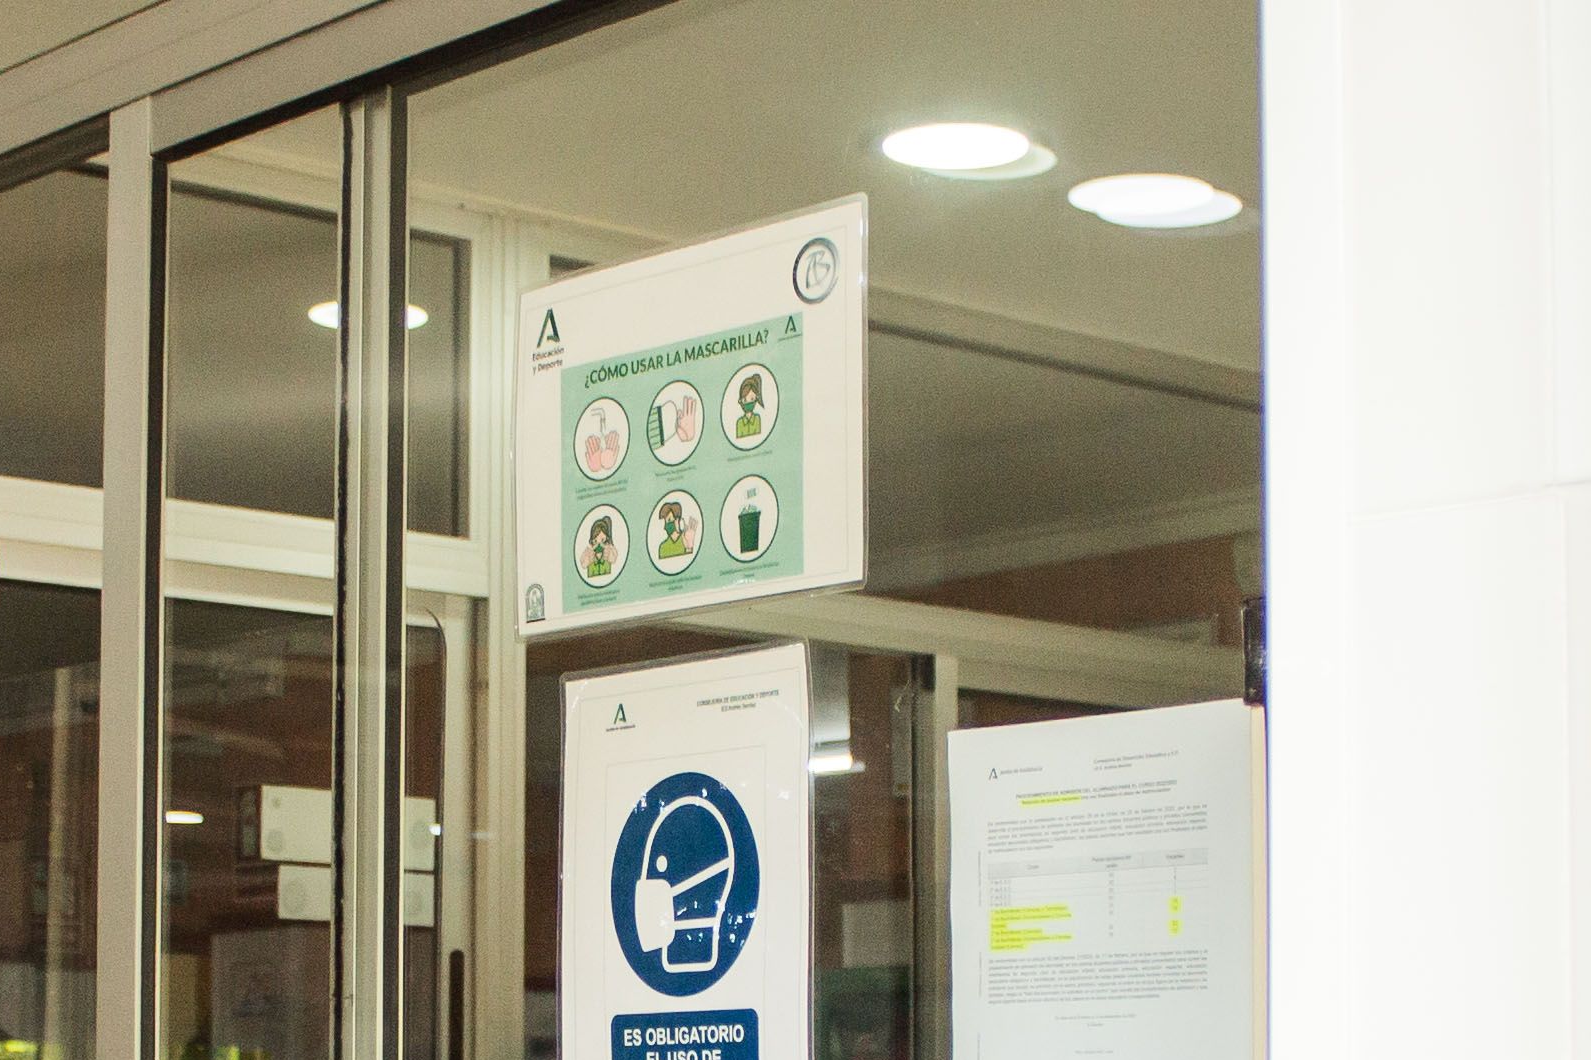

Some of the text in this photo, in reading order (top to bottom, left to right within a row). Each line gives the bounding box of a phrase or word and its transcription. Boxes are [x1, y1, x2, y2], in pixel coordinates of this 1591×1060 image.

[532, 346, 565, 362] Educación
[584, 328, 770, 389] ¿CÓMO USAR LA MASCARILLA?
[623, 1024, 745, 1047] ES OBLIGATORIO
